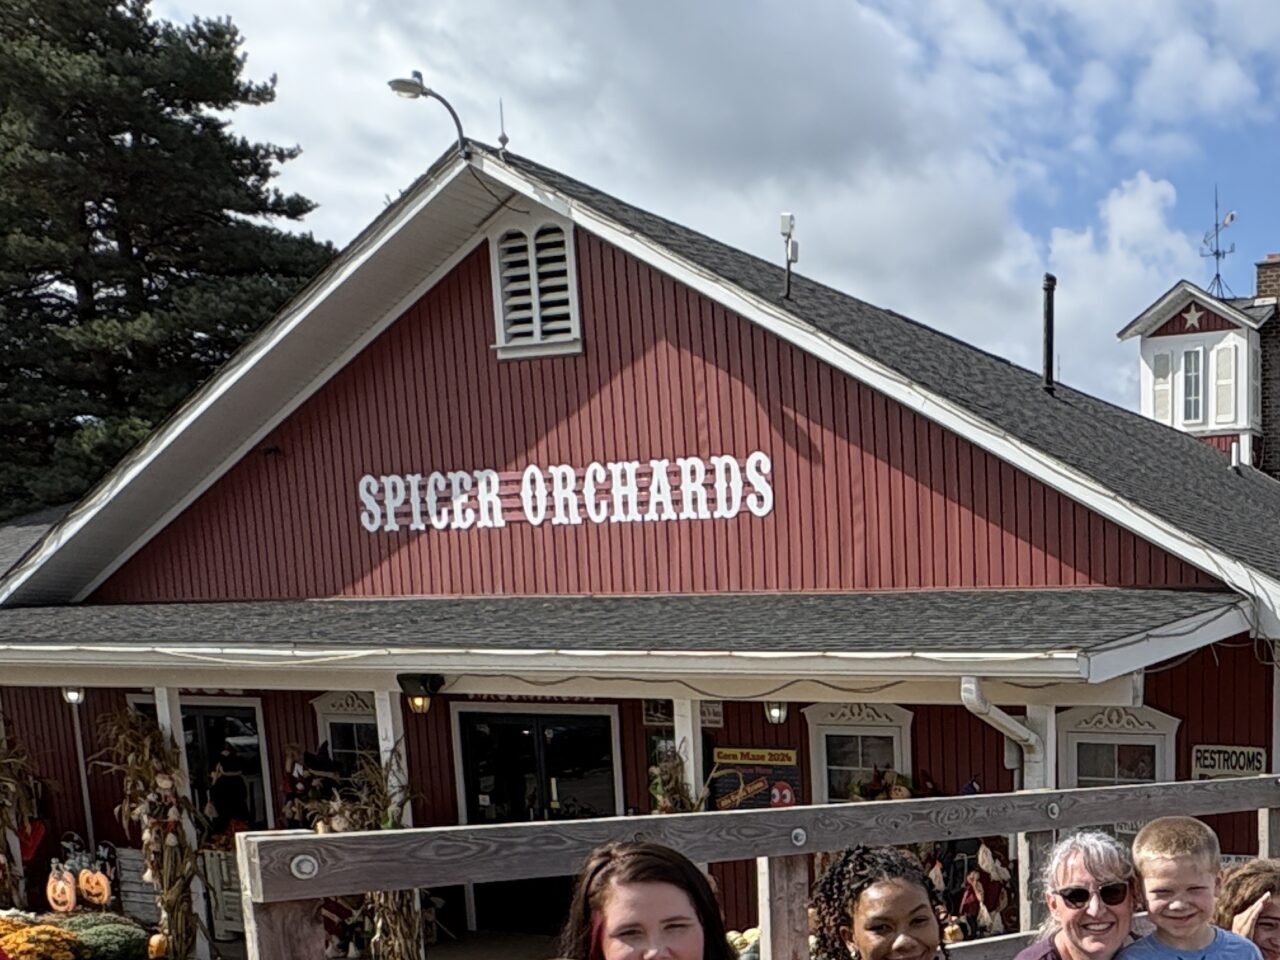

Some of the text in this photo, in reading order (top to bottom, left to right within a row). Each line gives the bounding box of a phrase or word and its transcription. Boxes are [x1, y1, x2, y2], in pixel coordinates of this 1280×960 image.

[358, 450, 774, 533] SPICER ORCHARDS
[716, 750, 738, 761] Corn
[740, 751, 766, 761] Maze
[1195, 748, 1263, 771] RESTROOMS
